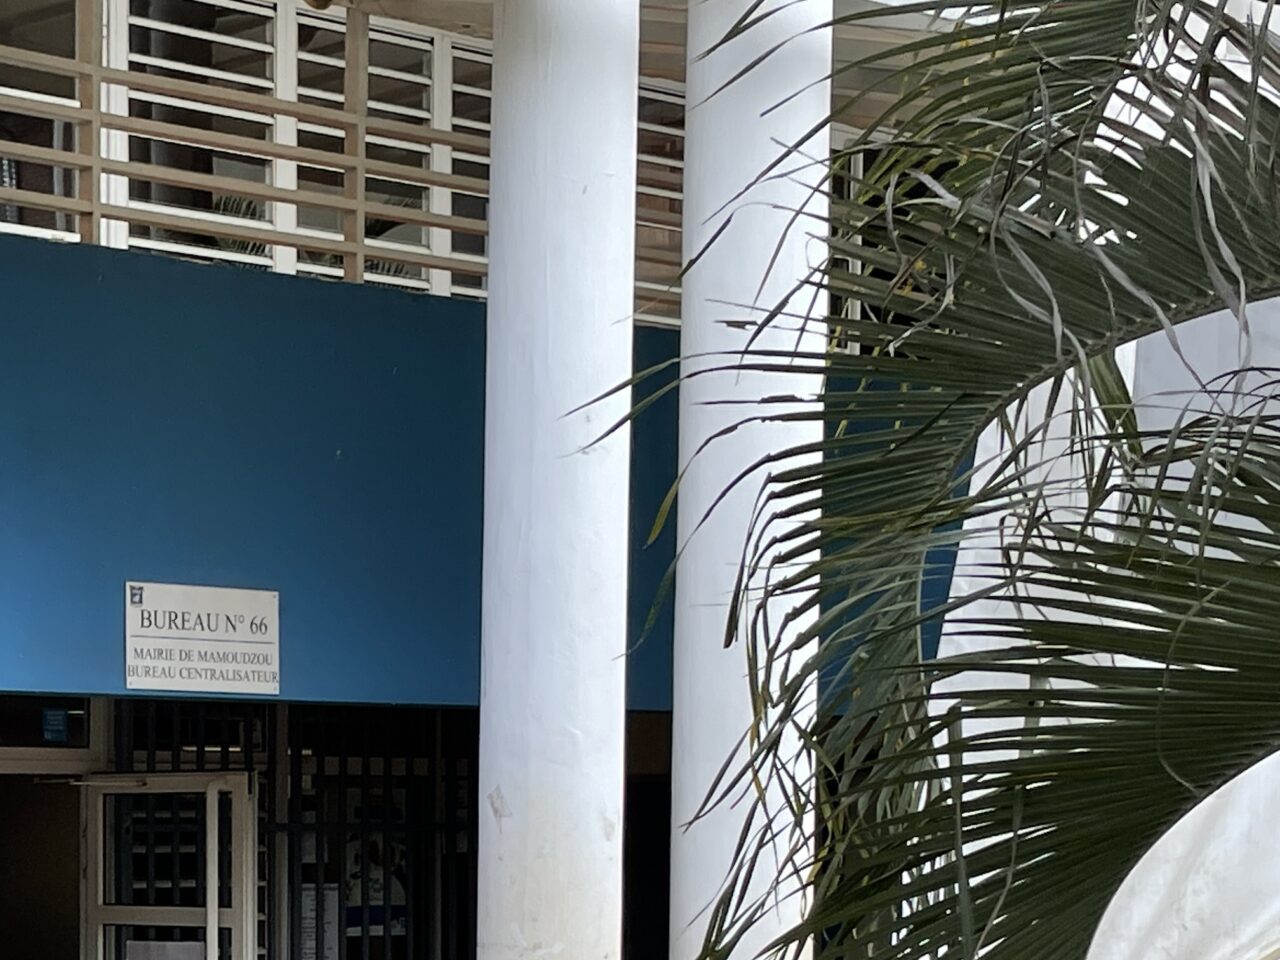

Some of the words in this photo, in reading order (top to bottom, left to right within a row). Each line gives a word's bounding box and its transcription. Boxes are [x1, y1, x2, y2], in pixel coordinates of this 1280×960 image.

[140, 608, 220, 632] BUREAU
[225, 614, 245, 633] N°
[250, 615, 268, 635] 66
[133, 647, 175, 662] MAIRIE
[179, 649, 194, 662] DE
[197, 650, 273, 666] MAMOUDZOU
[128, 664, 176, 678] BUREAU
[179, 666, 278, 683] CENTRALISATEUR
